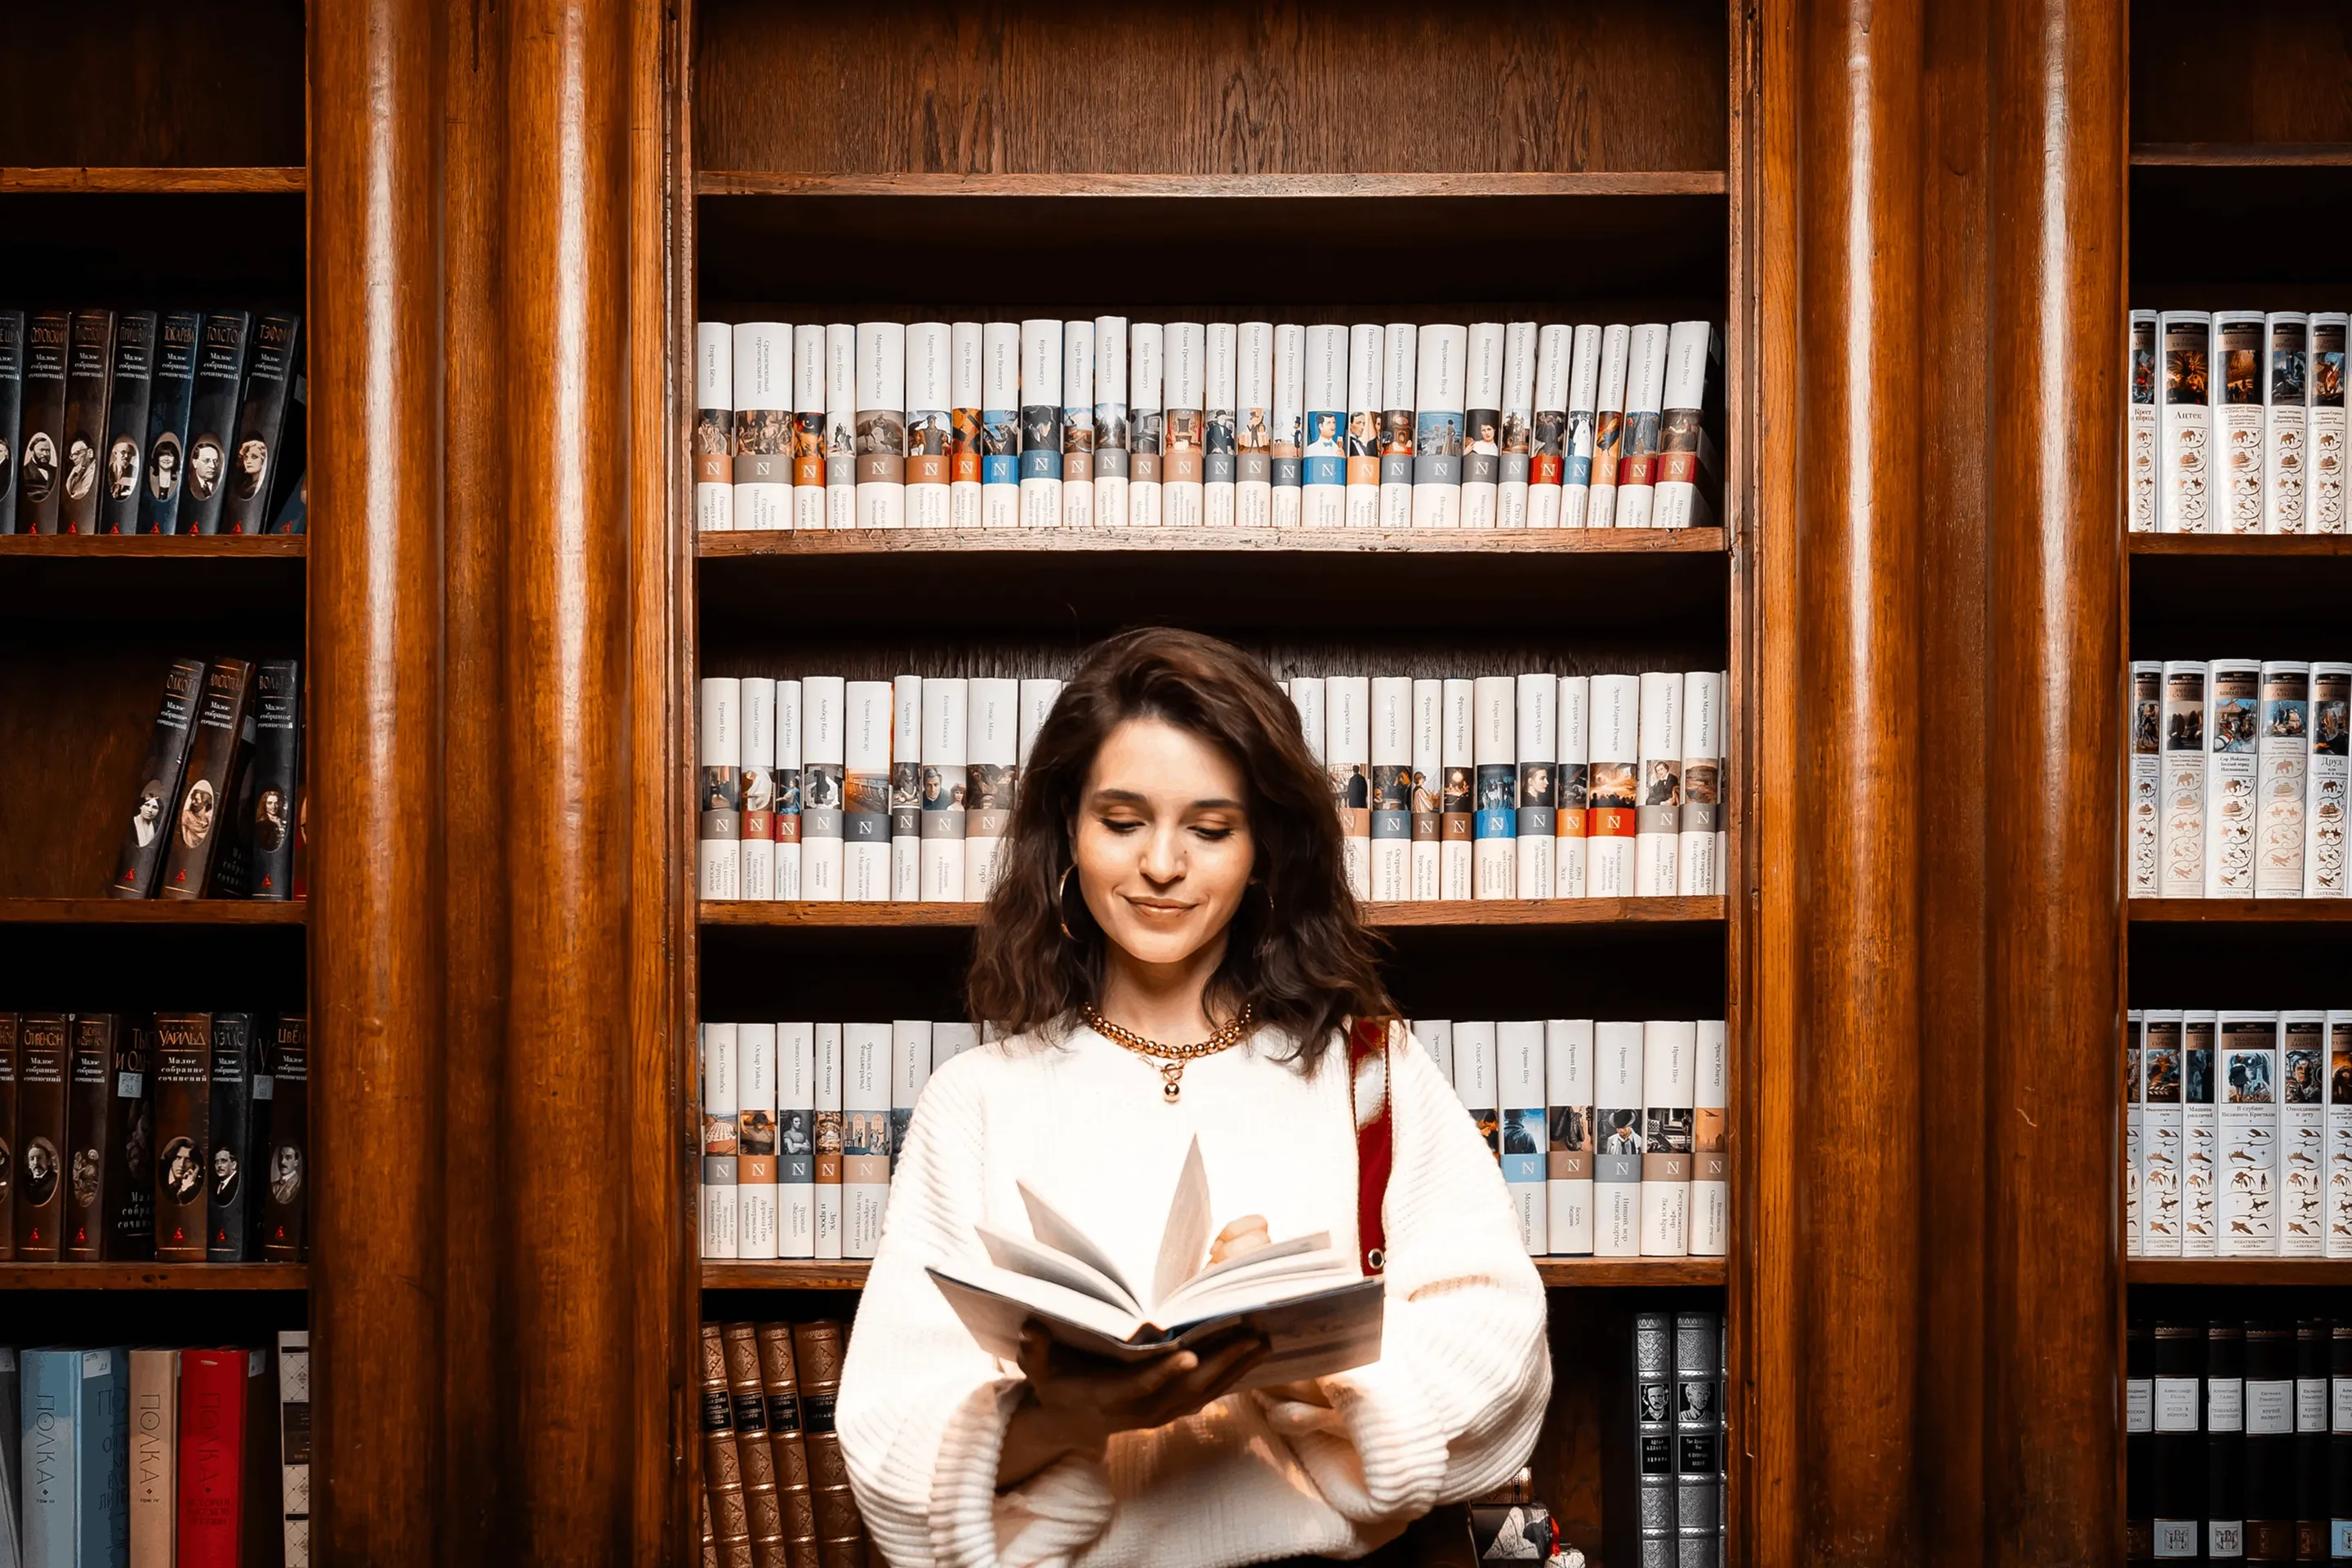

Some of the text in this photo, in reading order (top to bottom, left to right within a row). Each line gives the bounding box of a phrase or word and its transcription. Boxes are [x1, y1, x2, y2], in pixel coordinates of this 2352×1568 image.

[2175, 411, 2203, 421] Ацтек
[758, 462, 770, 474] N
[995, 463, 1006, 475] N
[1215, 461, 1227, 474] N
[1542, 463, 1554, 476] N
[2321, 756, 2343, 767] Друд
[751, 818, 763, 831] N
[860, 822, 872, 834] N
[1491, 817, 1503, 831] N
[158, 1030, 207, 1046] УАЙЛЬД
[168, 1057, 197, 1065] Малое
[161, 1066, 204, 1074] собрание
[793, 1163, 805, 1175] N
[1568, 1160, 1579, 1171] N
[36, 1395, 56, 1486] ПОЛКА
[140, 1394, 161, 1485] ПОЛКА
